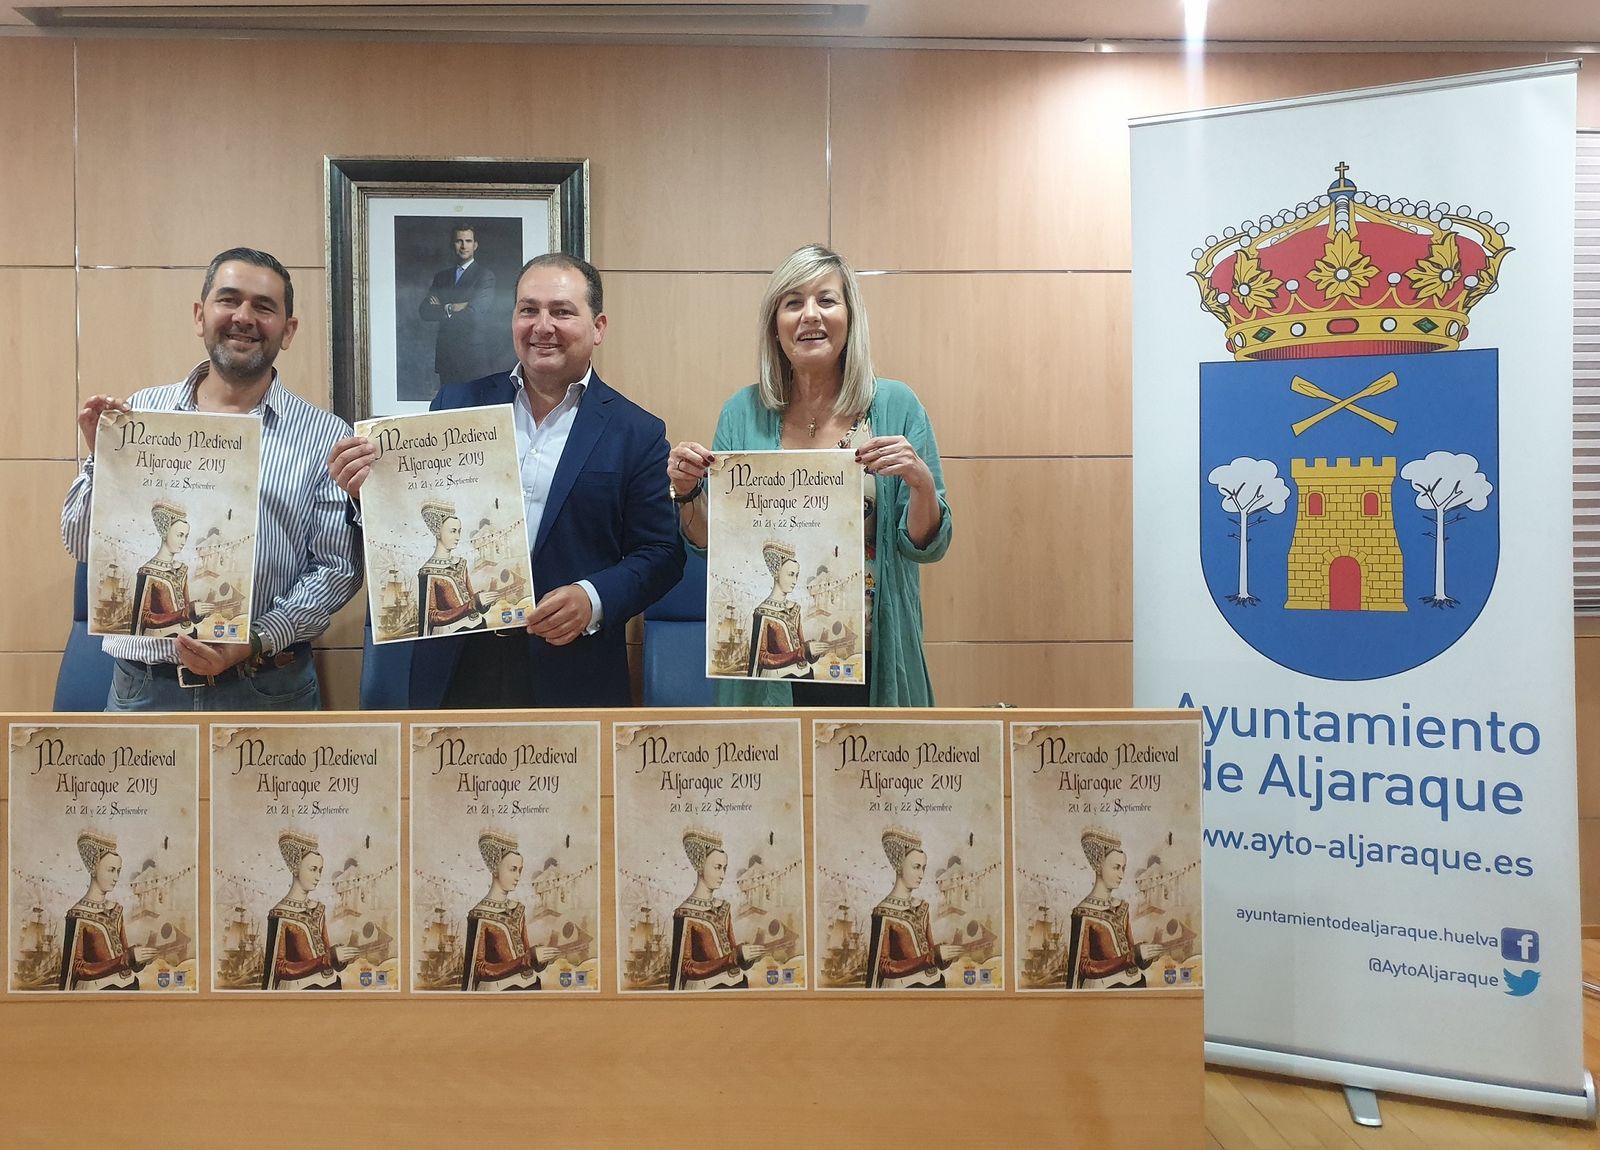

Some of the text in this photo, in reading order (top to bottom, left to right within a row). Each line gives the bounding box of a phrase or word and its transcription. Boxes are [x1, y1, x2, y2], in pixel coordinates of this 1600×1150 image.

[114, 420, 242, 453] Mercado Medieval
[374, 426, 498, 460] Mercado Medieval
[136, 450, 226, 475] Aljaraque 2019
[398, 451, 484, 478] Aljaraque 2019
[155, 478, 163, 488] 21
[170, 480, 180, 488] 22
[420, 480, 428, 489] 21
[434, 478, 444, 487] 22
[725, 463, 844, 494] Mercado Medieval
[745, 492, 829, 516] Aljaraque 2019
[764, 520, 772, 528] 21
[778, 519, 787, 528] 22
[31, 739, 176, 775] Mercado Medieval
[231, 739, 377, 775] Mercado Medieval
[432, 738, 577, 775] Mercado Medieval
[635, 736, 779, 774] Mercado Medieval
[834, 735, 980, 771] Mercado Medieval
[1033, 737, 1179, 773] Mercado Medieval
[56, 772, 158, 801] Aljaraque 2019
[256, 772, 359, 800] Aljaraque 2019
[456, 772, 560, 800] Aljaraque 2019
[660, 771, 761, 798] Aljaraque 2019
[860, 769, 962, 798] Aljaraque 2019
[1058, 771, 1161, 799] Aljaraque 2019
[1258, 753, 1524, 822] Aljaraque
[80, 805, 88, 815] 21
[96, 806, 107, 815] 22
[110, 801, 148, 820] Septiembre
[280, 805, 289, 815] 21
[297, 805, 308, 815] 22
[311, 800, 350, 819] Septiembre
[480, 804, 489, 814] 21
[497, 805, 508, 814] 22
[511, 800, 550, 818] Septiembre
[684, 802, 693, 812] 21
[701, 802, 712, 812] 22
[714, 798, 752, 816] Septiembre
[884, 802, 892, 811] 21
[900, 802, 911, 811] 22
[914, 797, 952, 816] Septiembre
[1083, 803, 1091, 812] 21
[1100, 802, 1111, 812] 22
[1113, 798, 1152, 816] Septiembre
[1203, 828, 1535, 877] ww.ayto-aljaraque.es
[1236, 907, 1499, 948] ayuntamientodealjaraque.huelva
[1368, 957, 1499, 988] @AytoAljaraque
